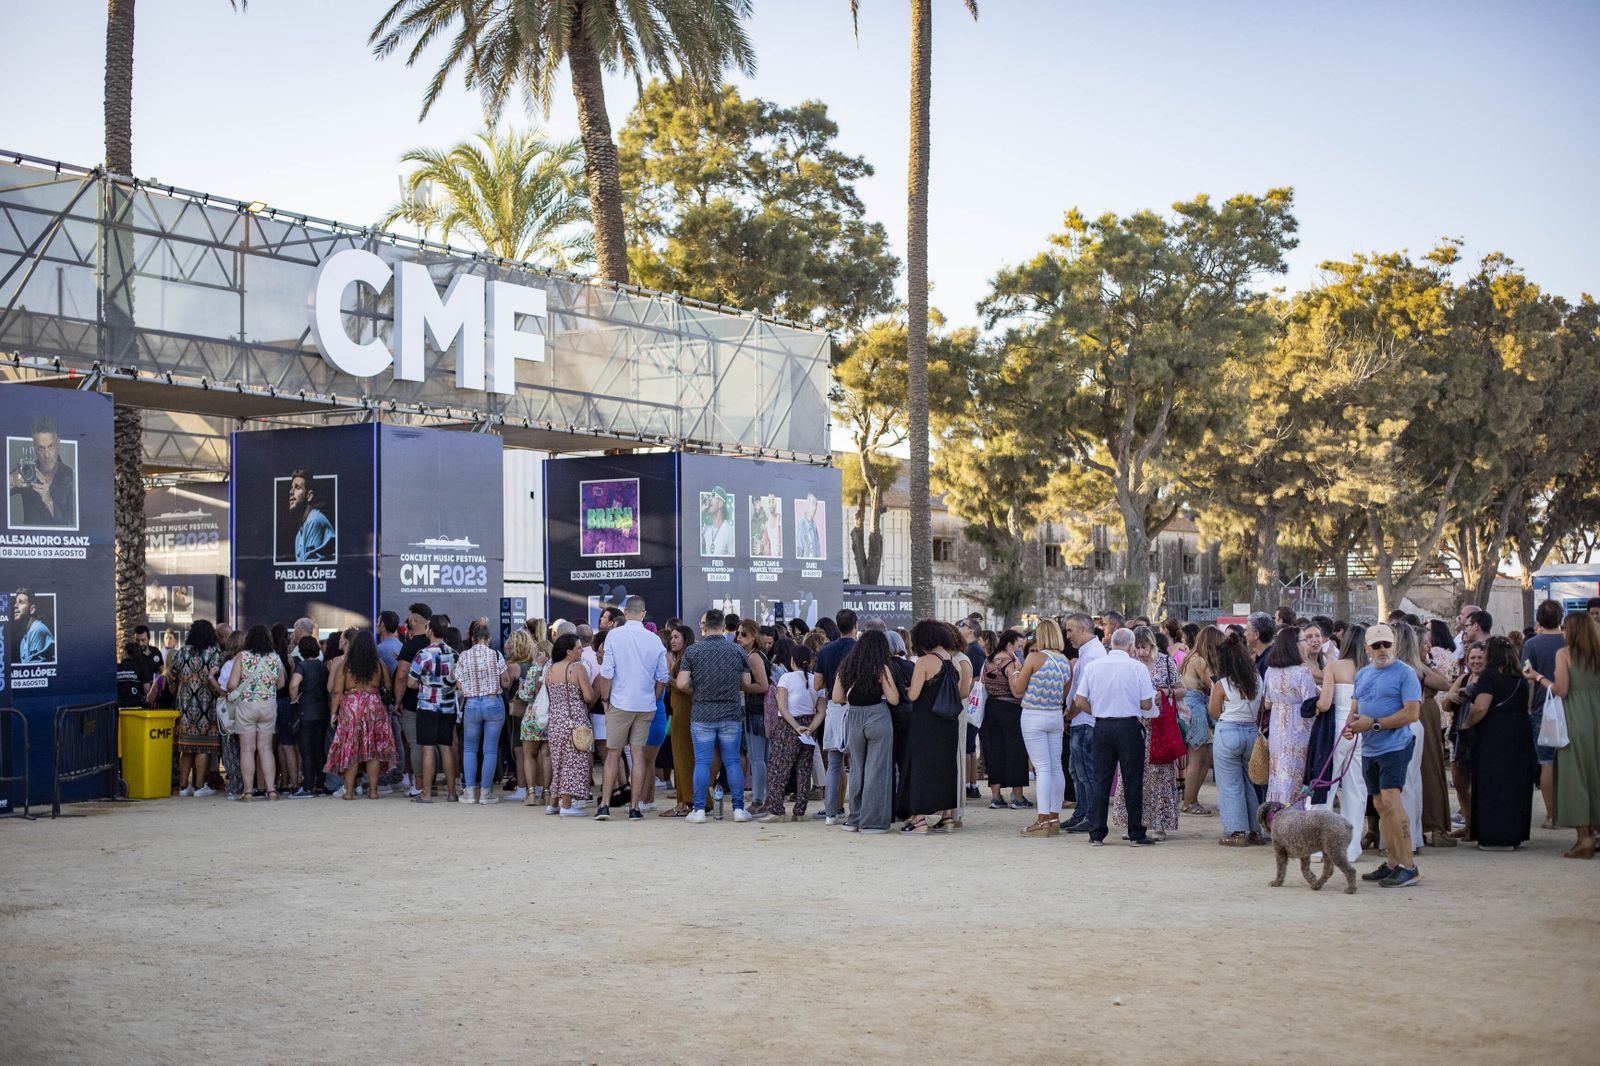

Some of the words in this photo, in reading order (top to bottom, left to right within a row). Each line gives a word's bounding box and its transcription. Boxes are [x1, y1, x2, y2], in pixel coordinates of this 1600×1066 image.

[308, 249, 547, 395] CMF
[0, 534, 62, 546] ALEJANDRO
[62, 536, 90, 546] SANZ
[400, 554, 432, 562] CONCERT
[596, 560, 625, 568] BRESH
[275, 570, 305, 580] PABLO
[307, 566, 336, 579] LÓPEZ
[868, 601, 895, 611] TICKETS
[31, 666, 57, 677] LÓPEZ
[149, 728, 171, 740] CMF
